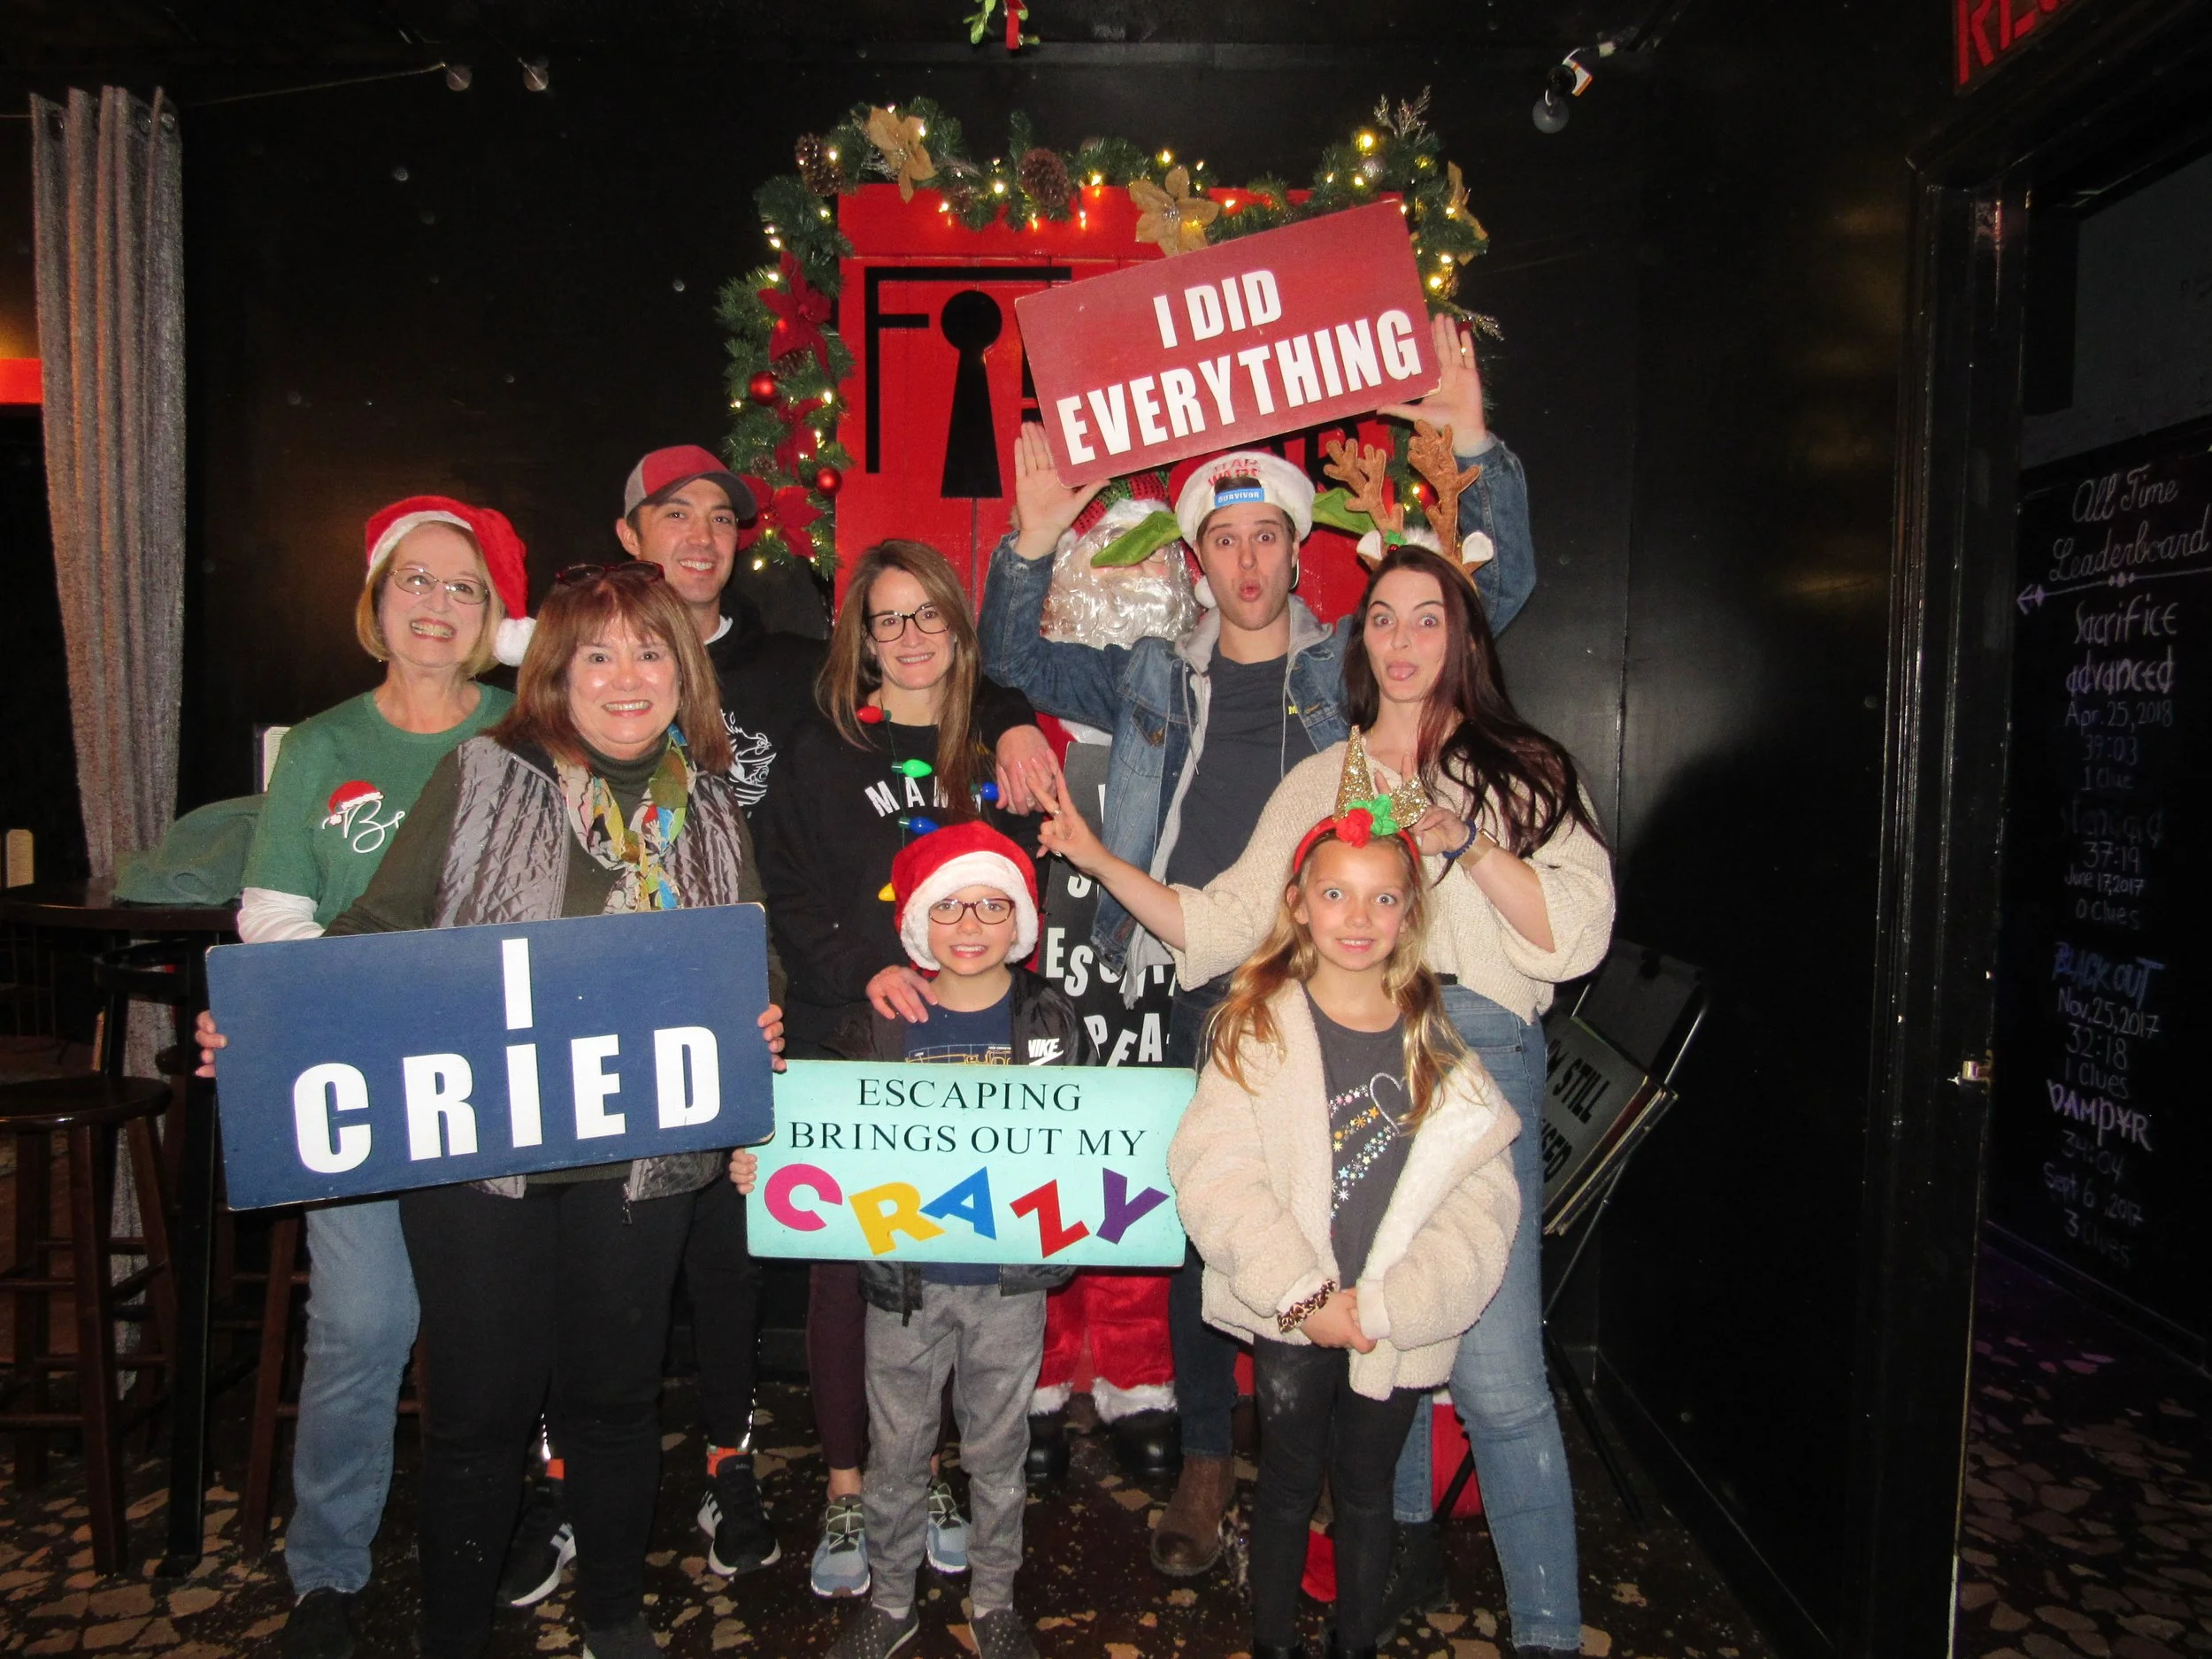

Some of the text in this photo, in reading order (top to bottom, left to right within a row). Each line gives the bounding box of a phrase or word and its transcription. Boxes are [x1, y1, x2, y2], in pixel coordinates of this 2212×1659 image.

[1153, 269, 1282, 349] I DID
[1056, 310, 1421, 465] EVERYTHING
[2072, 461, 2179, 524] All Time
[2049, 502, 2212, 581] Leaderboard
[502, 938, 533, 1030] I
[2065, 1022, 2128, 1070] 32:18
[857, 1078, 1083, 1111] ESCAPING
[1553, 1057, 1610, 1124] STILL
[790, 1121, 1148, 1156] BRINGS OUT MY
[764, 1163, 1171, 1258] CRAZY
